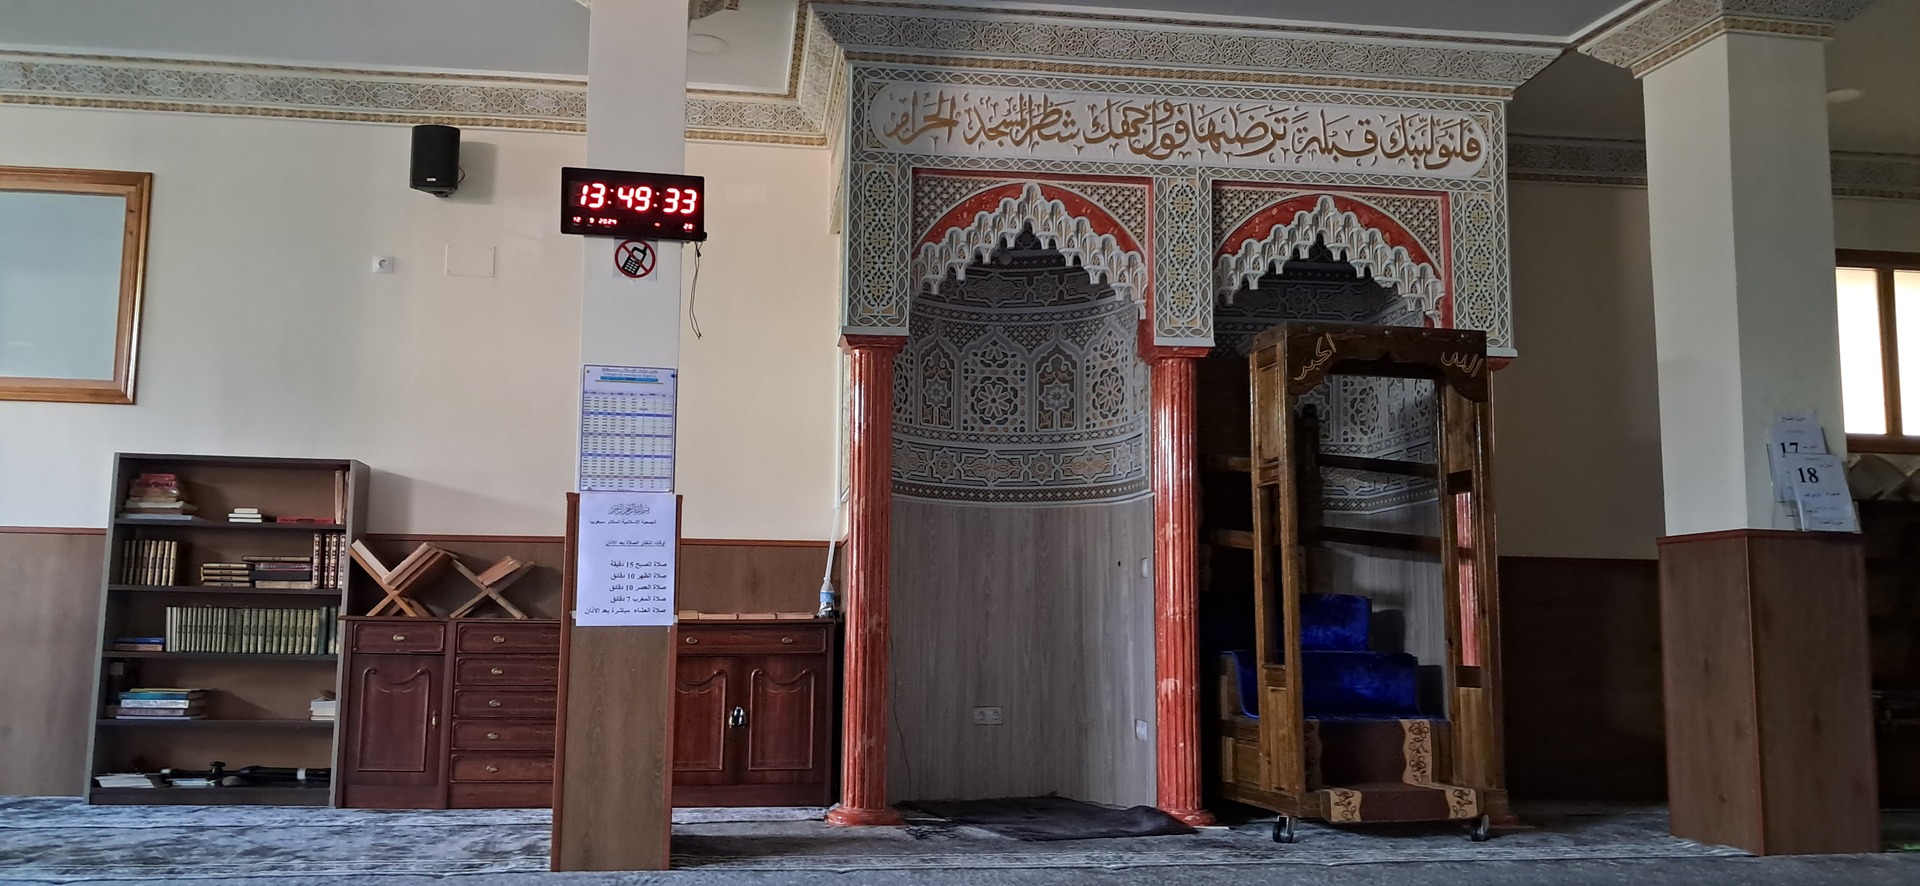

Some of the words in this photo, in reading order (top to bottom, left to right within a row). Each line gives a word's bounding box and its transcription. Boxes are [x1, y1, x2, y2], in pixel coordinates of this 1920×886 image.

[580, 182, 698, 214] 13:49:33
[598, 217, 618, 225] 2024
[1797, 467, 1819, 484] 18
[610, 559, 624, 567] دقيقة
[635, 560, 652, 569] الصبح
[610, 572, 625, 580] دقائق
[637, 572, 651, 580] الظهر
[609, 583, 624, 591] دقائق
[610, 595, 625, 603] دقائق
[632, 595, 651, 603] المغرب
